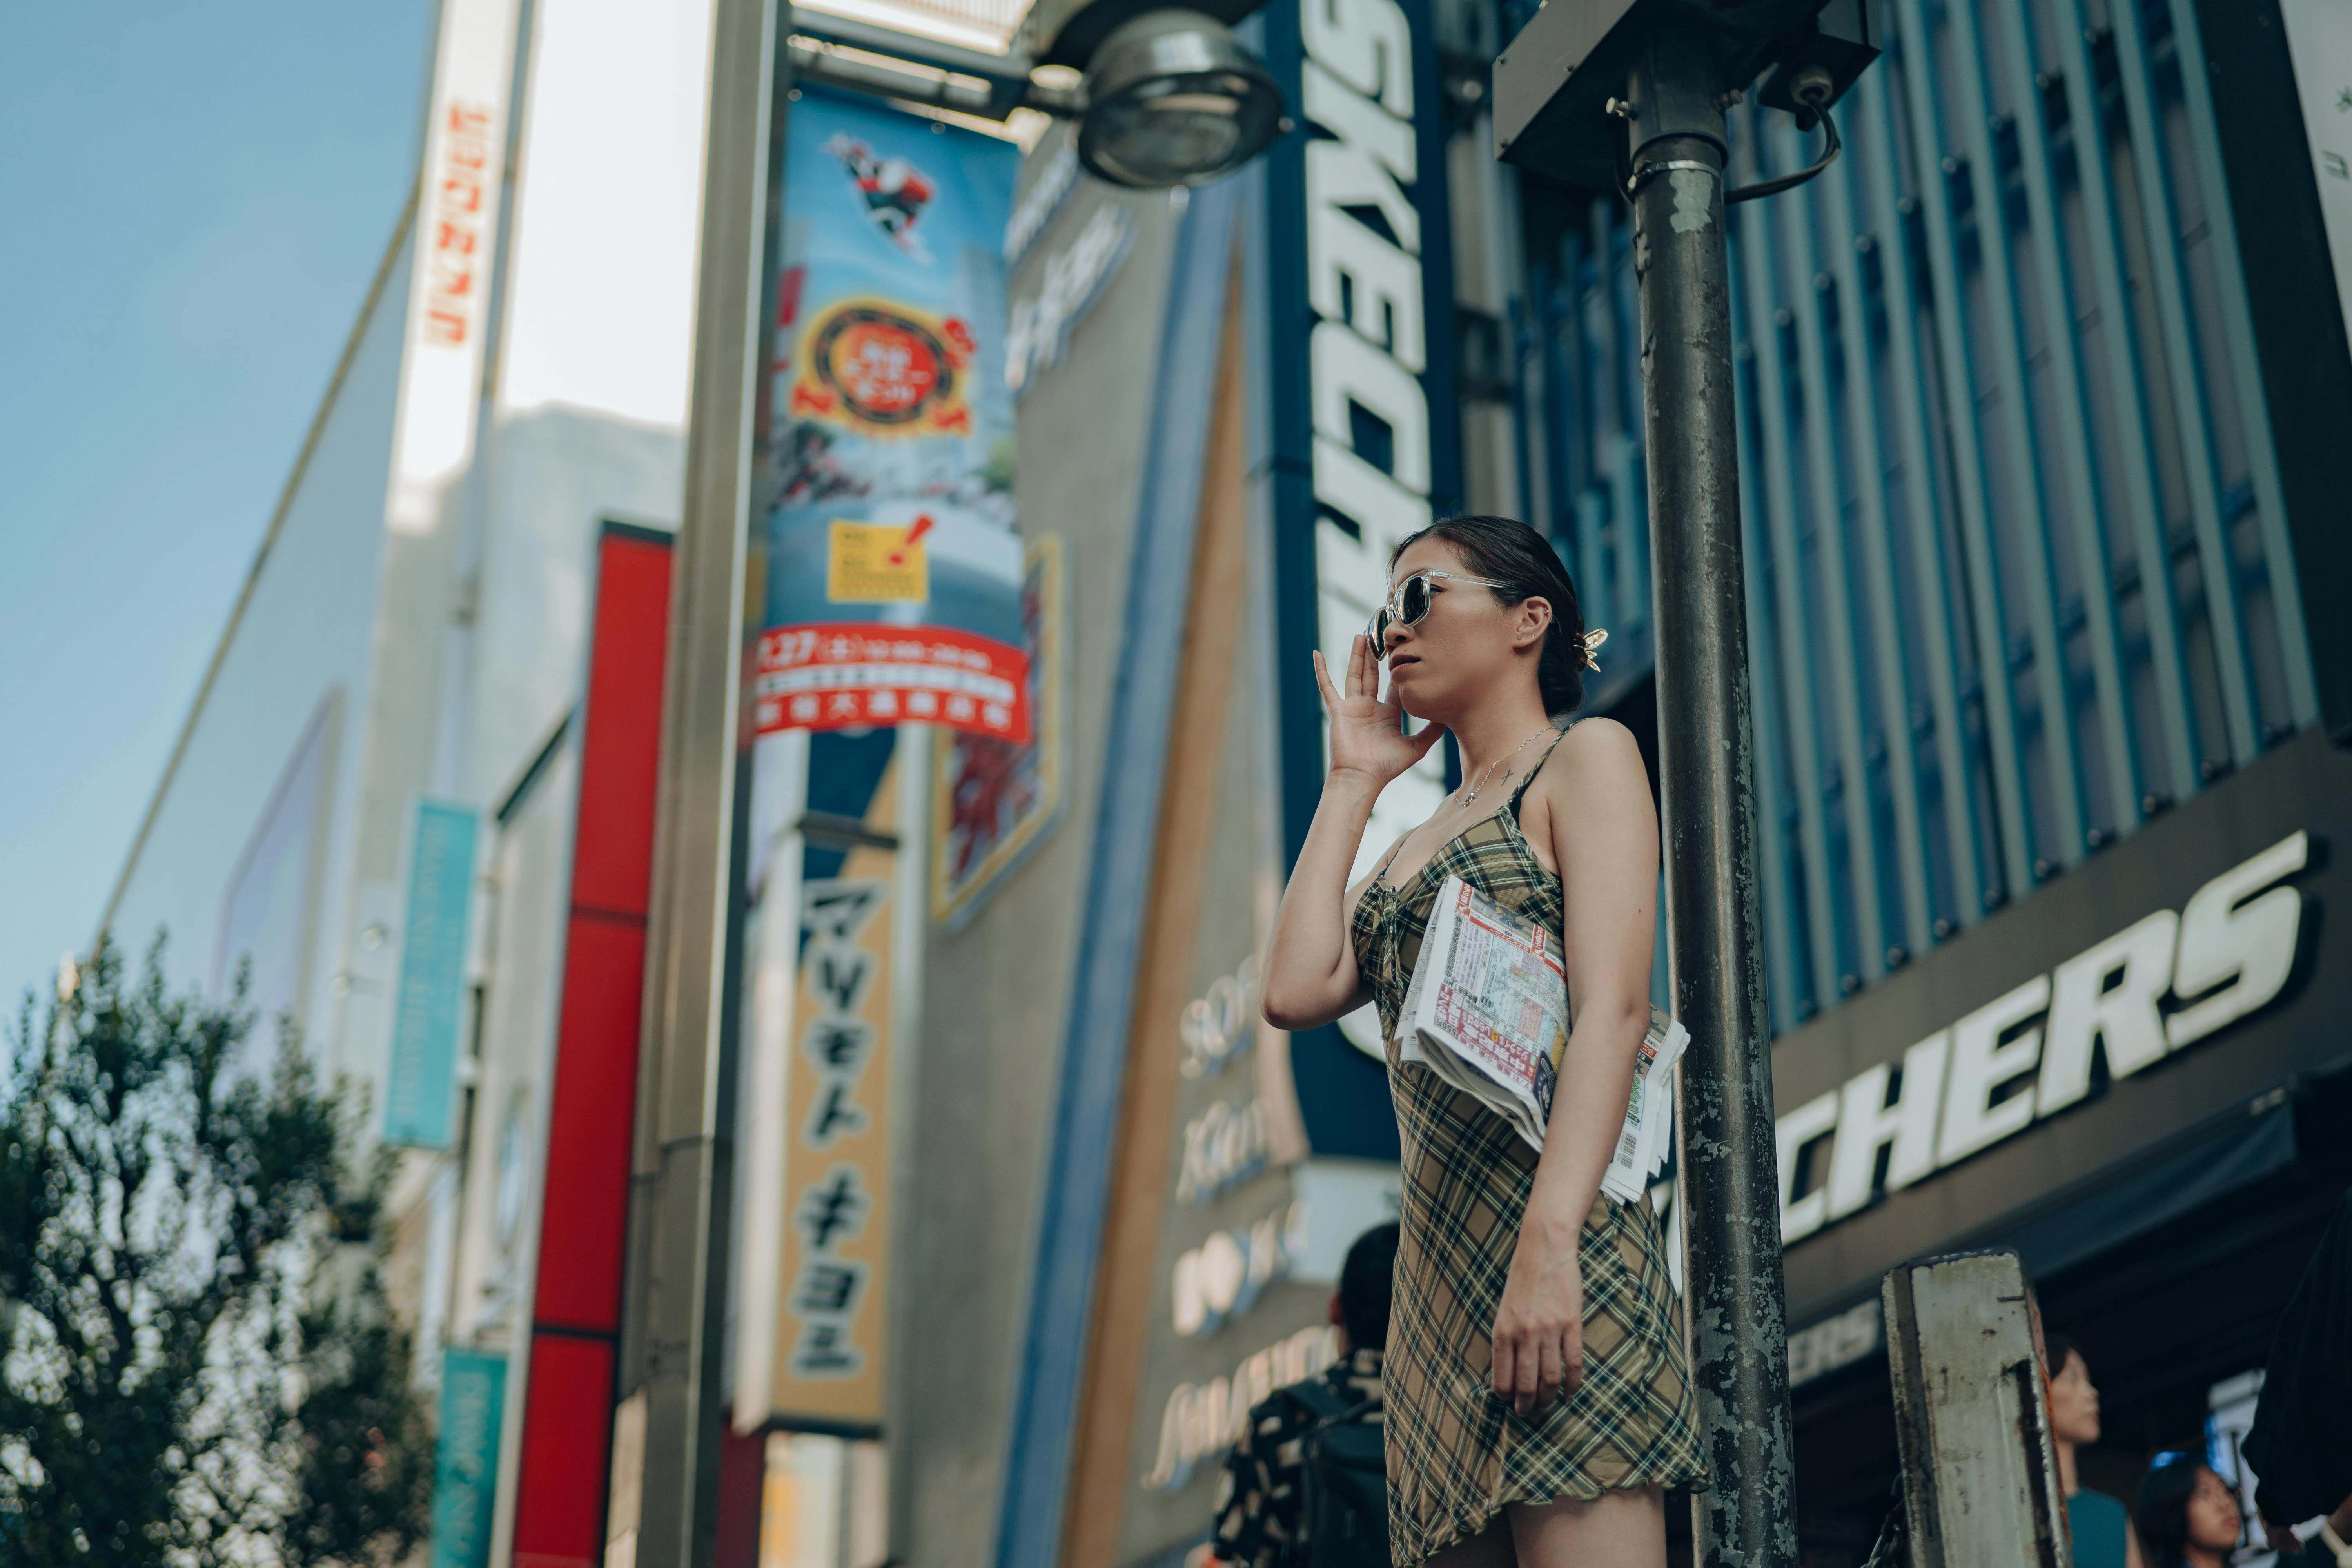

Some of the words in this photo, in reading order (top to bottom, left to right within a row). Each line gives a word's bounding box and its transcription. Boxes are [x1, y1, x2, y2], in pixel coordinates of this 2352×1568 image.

[1447, 990, 1463, 1027] 日曜版
[1481, 996, 1491, 1007] 11
[1435, 1017, 1457, 1036] 550円
[1461, 1011, 1490, 1036] しらかばS
[1462, 1023, 1526, 1072] 中京記念
[1498, 1035, 1528, 1061] ジュライS
[1648, 830, 2307, 1297] CHERS
[1512, 1074, 1530, 1089] 7/21
[794, 878, 885, 1378] マツモトキヨシ
